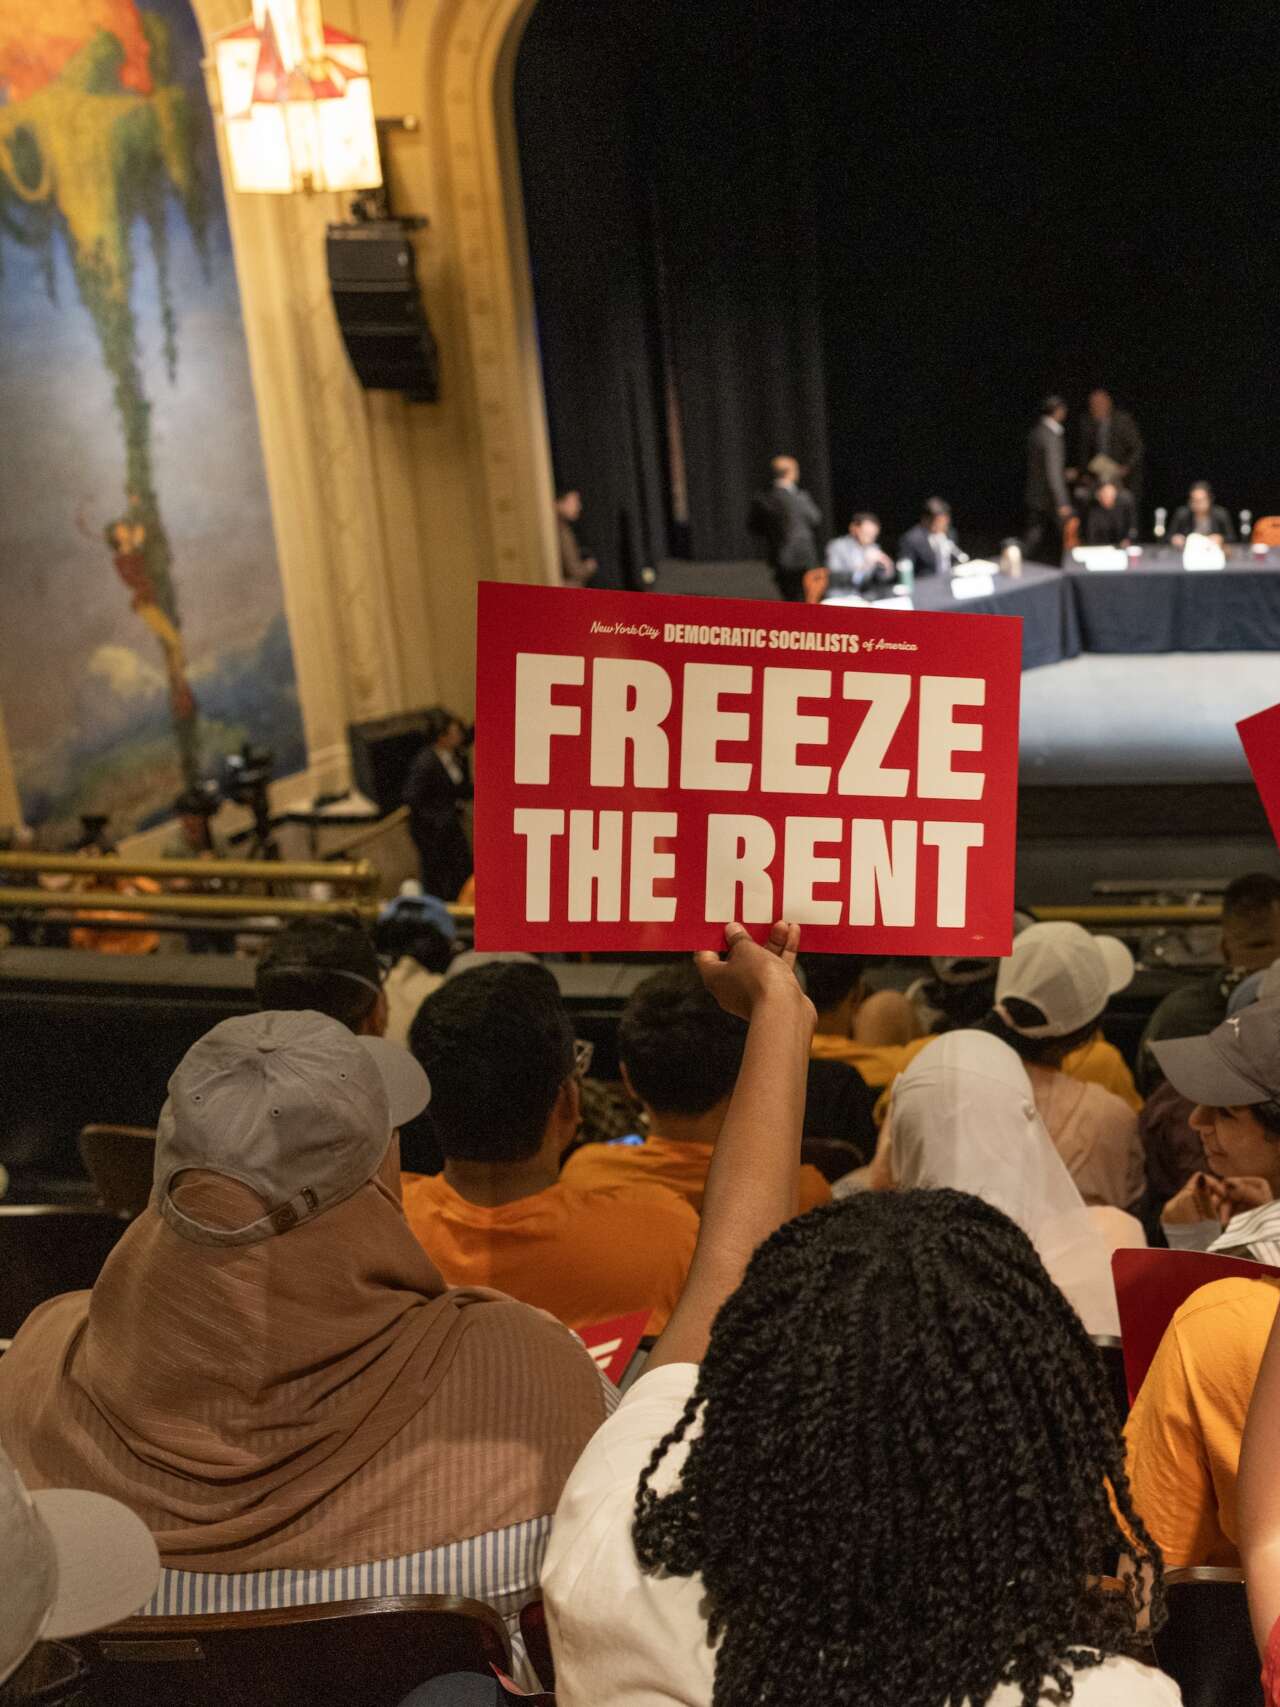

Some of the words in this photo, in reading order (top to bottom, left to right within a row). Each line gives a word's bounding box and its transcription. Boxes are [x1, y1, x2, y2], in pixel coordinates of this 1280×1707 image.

[590, 621, 615, 634] New
[638, 624, 660, 640] City
[663, 623, 767, 648] DEMOCRATIC
[768, 629, 860, 654] SOCIALISTS
[862, 638, 875, 652] of
[874, 638, 918, 651] America
[514, 653, 986, 800] FREEZE
[514, 808, 678, 923] THE
[705, 813, 985, 928] RENT
